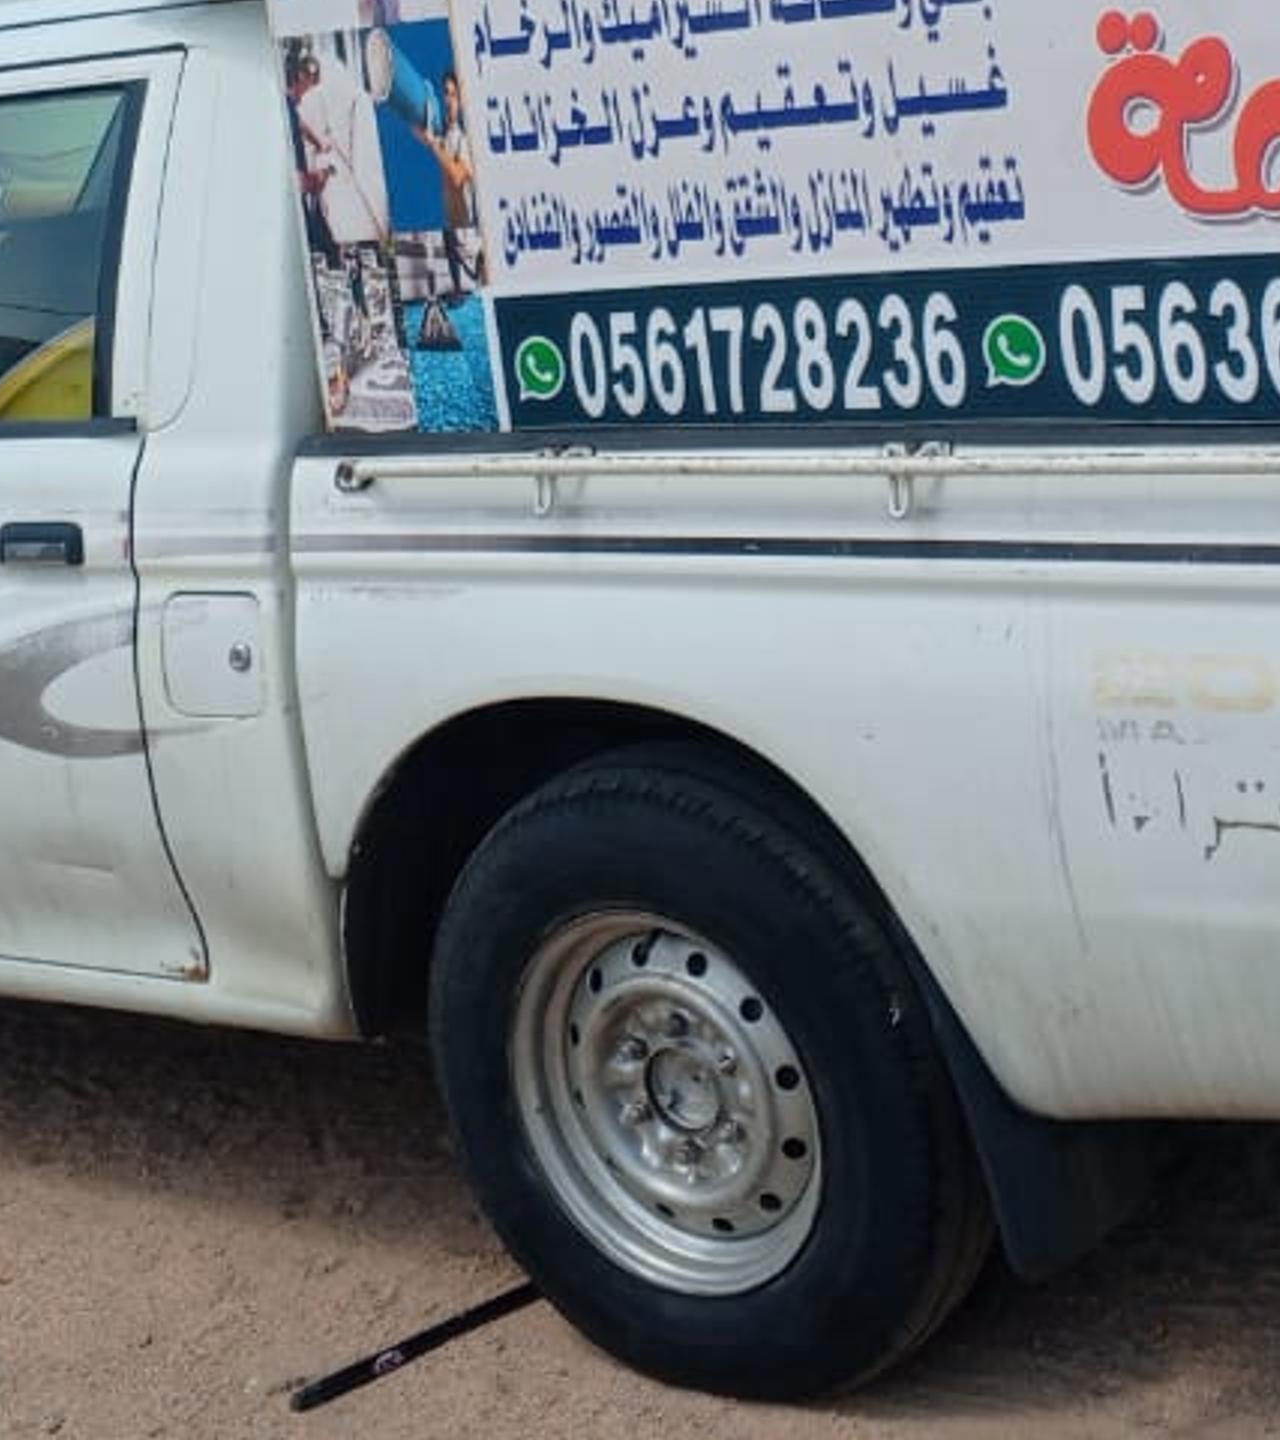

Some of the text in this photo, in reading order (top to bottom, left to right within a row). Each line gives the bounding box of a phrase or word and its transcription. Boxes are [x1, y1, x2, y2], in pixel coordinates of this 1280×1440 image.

[486, 44, 1008, 166] غسيل وتعقيم وعزل الخزانات
[499, 191, 582, 267] والفنادق
[584, 184, 662, 264] والقصور
[726, 168, 802, 257] والشقق
[808, 168, 872, 253] المنازل
[880, 162, 954, 252] وتطهير
[958, 155, 1025, 246] تعقيم
[568, 290, 967, 420] 0561728236
